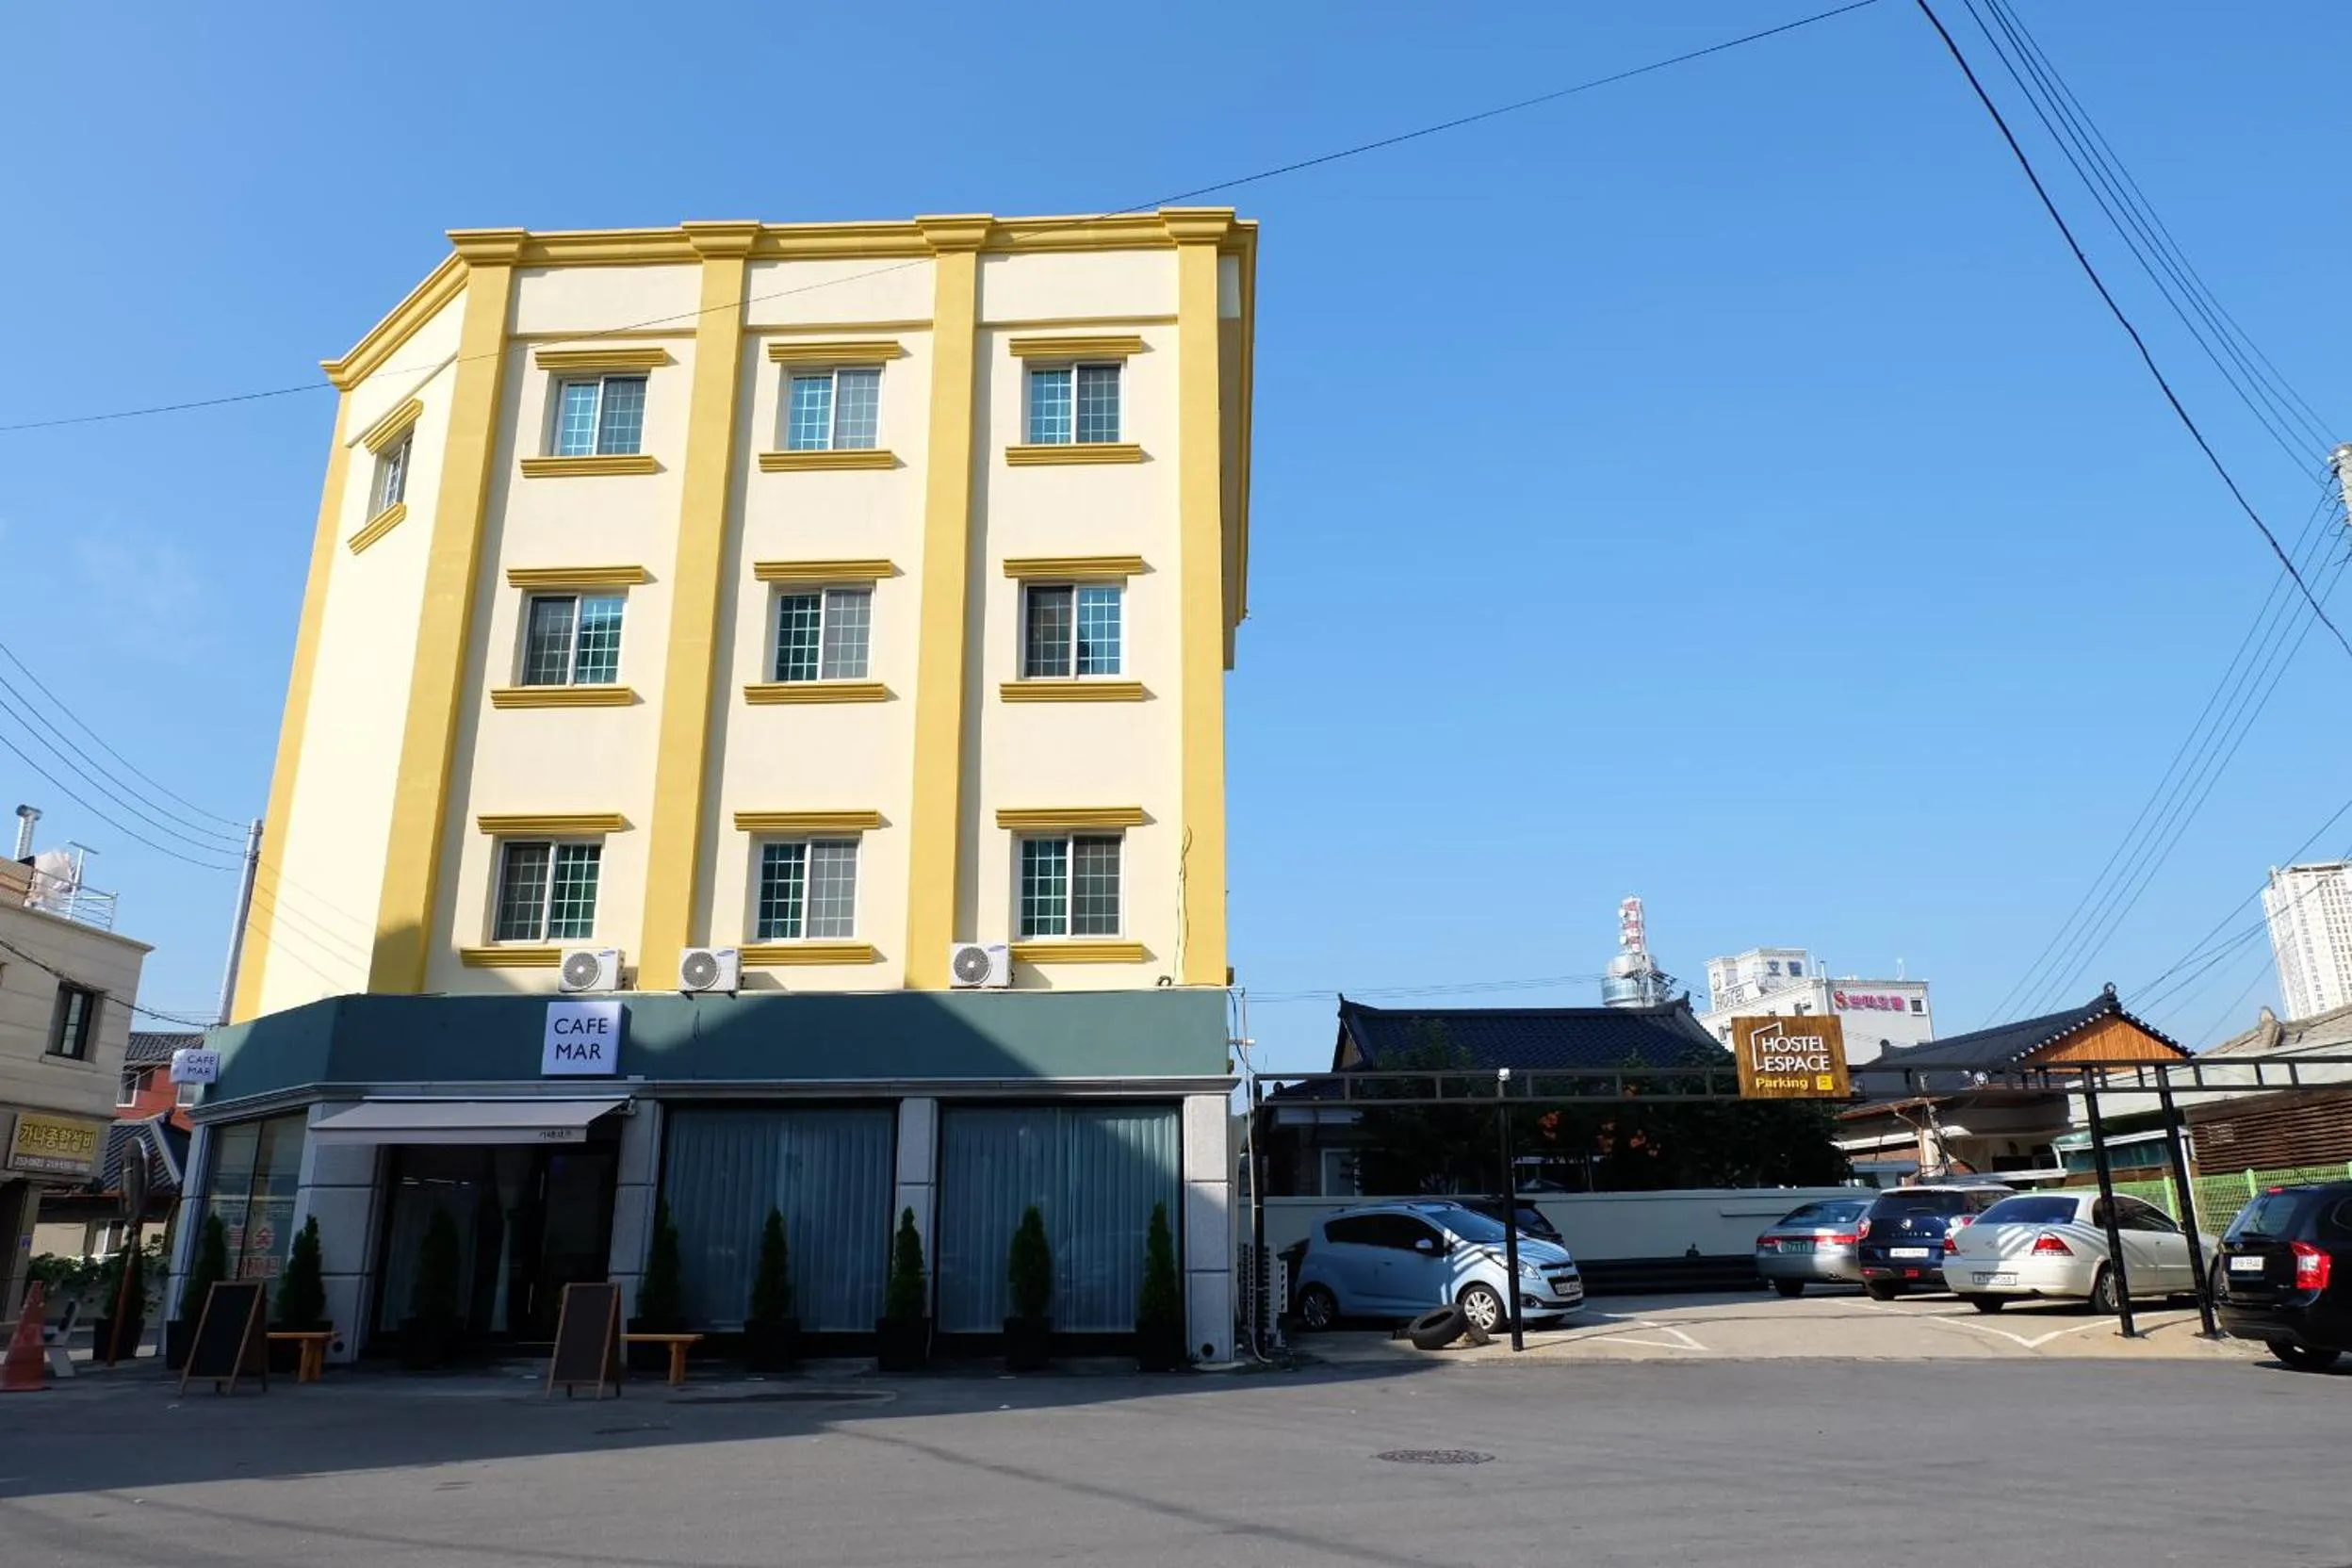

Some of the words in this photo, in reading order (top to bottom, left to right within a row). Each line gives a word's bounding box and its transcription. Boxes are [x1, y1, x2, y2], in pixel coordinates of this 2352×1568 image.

[554, 1018, 609, 1035] CAFE
[555, 1042, 602, 1060] MAR
[1762, 1036, 1829, 1053] HOSTEL
[188, 1054, 216, 1065] CAFE
[1764, 1054, 1832, 1071] ESPACE
[188, 1066, 211, 1075] MAR
[1756, 1076, 1809, 1090] Parking
[19, 1123, 95, 1154] 가나종합설비
